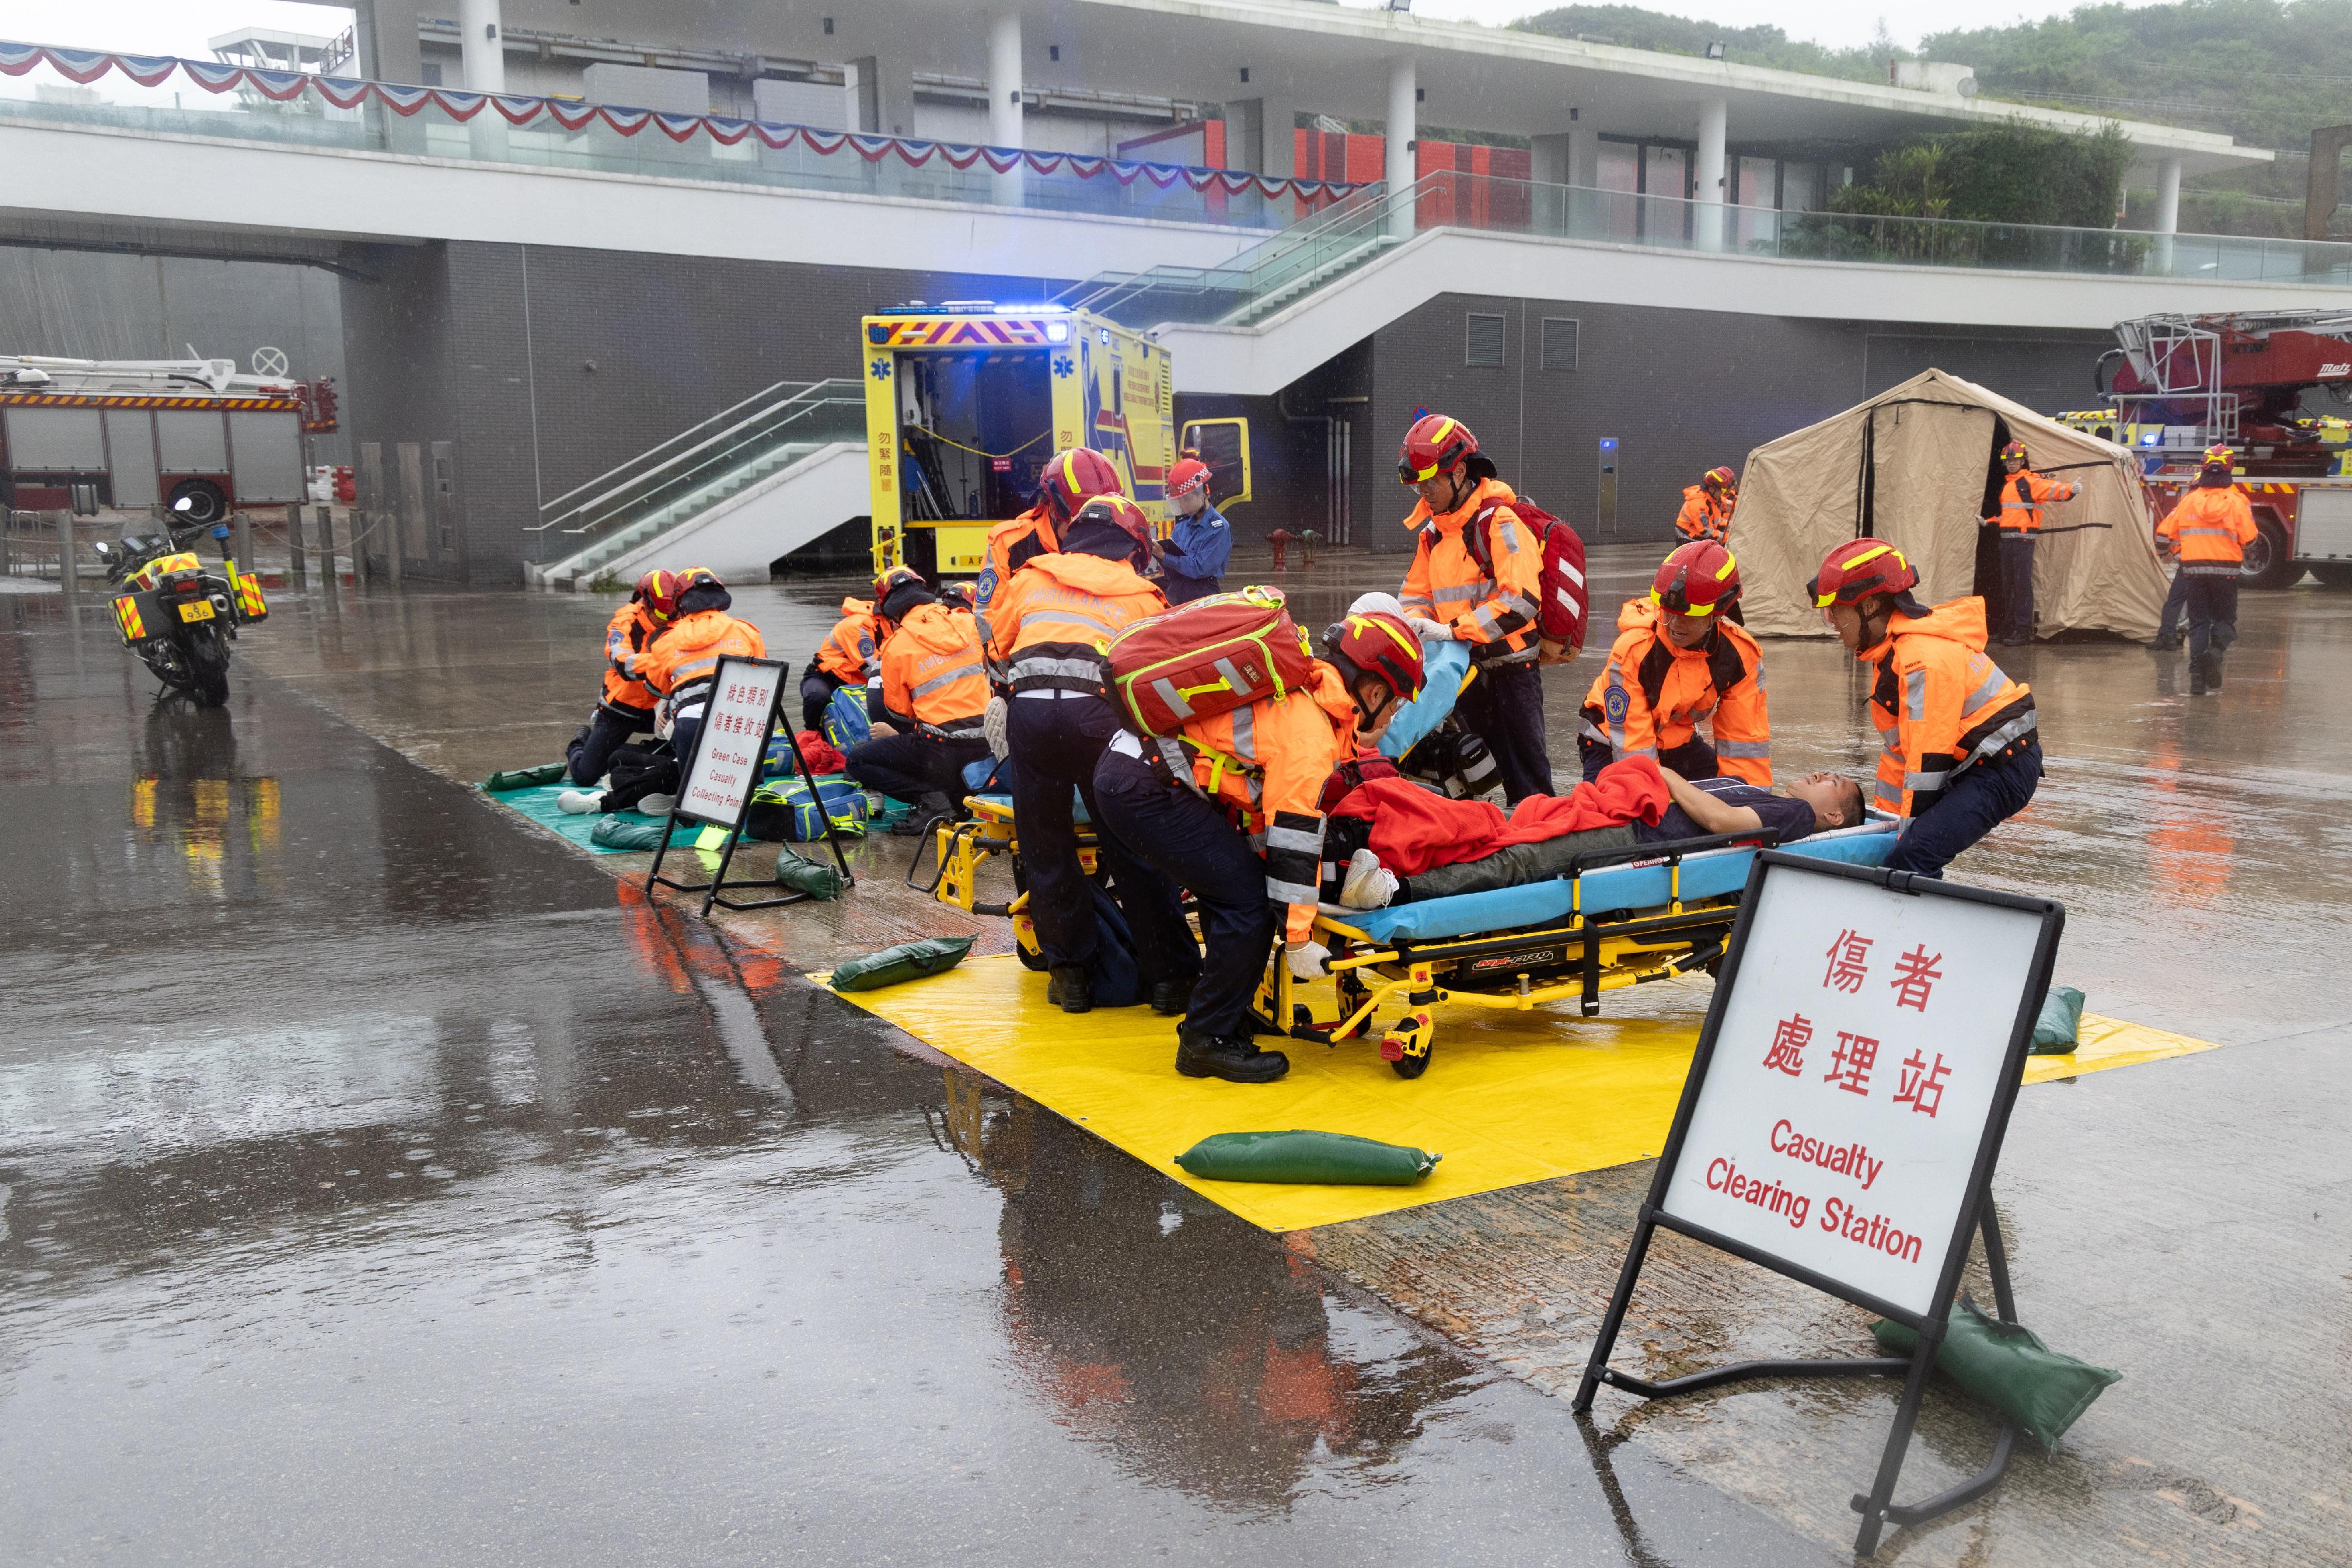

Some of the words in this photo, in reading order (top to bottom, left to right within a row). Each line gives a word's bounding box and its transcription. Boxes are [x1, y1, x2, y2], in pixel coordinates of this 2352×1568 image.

[727, 683, 769, 707] 綠色類別
[713, 711, 765, 739] 傷者接收站
[712, 748, 730, 762] Green
[732, 753, 748, 765] Case
[710, 769, 737, 787] Casualty
[692, 787, 723, 806] Collecting
[725, 794, 743, 810] Point
[1639, 857, 1663, 866] FERNO
[1477, 951, 1551, 967] MX-PRO
[1823, 929, 1942, 1012] 傷者
[1763, 1013, 1952, 1118] 處理站
[1770, 1119, 1883, 1190] Casualty
[1706, 1158, 1810, 1228] Clearing
[1820, 1196, 1922, 1263] Station
